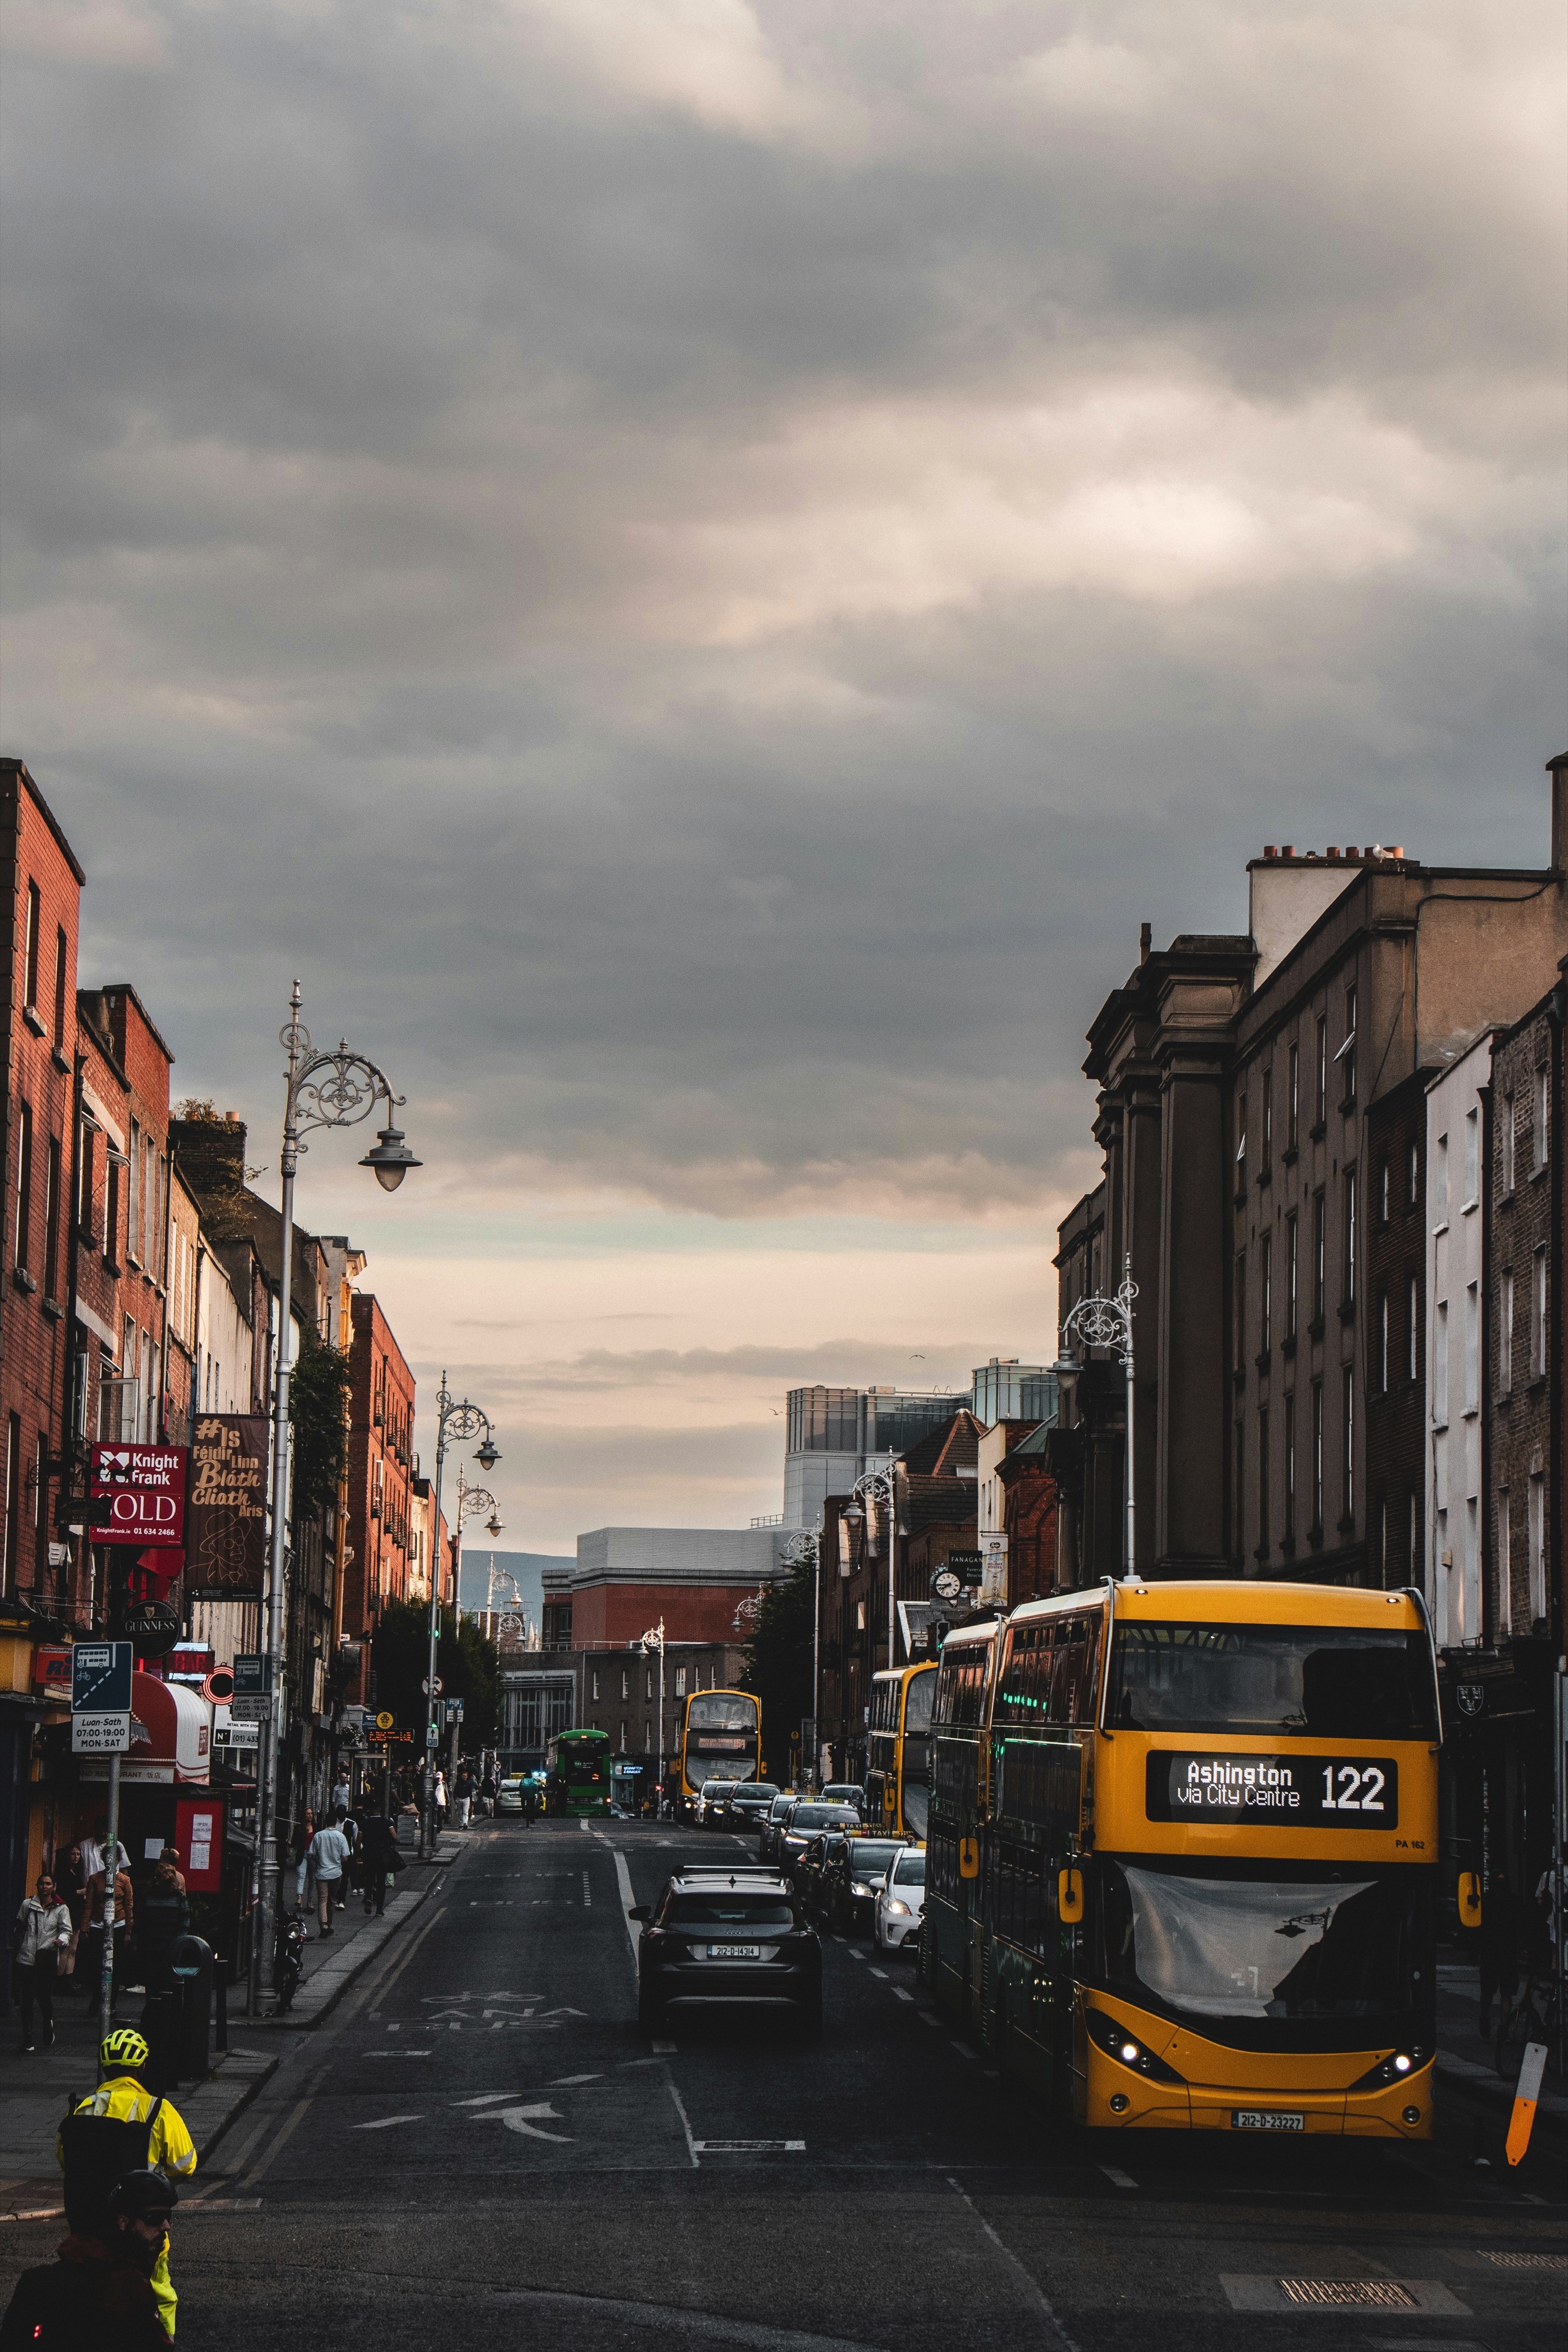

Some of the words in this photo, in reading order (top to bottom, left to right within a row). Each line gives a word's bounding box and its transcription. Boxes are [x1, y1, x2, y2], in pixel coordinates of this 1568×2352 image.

[193, 1445, 232, 1460] Féidir
[133, 1452, 179, 1471] Knight
[232, 1455, 259, 1468] Linn
[132, 1470, 170, 1485] Frank
[195, 1459, 260, 1488] Bláth
[192, 1488, 251, 1506] Cliath
[99, 1494, 176, 1521] OLD
[239, 1505, 263, 1517] Arís
[125, 1621, 175, 1632] GUINNESS
[175, 1653, 206, 1671] BAR
[82, 1718, 122, 1726] Luan-Sath
[76, 1729, 125, 1737] 07:00-19:00
[81, 1739, 121, 1748] MON-SAT
[1188, 1761, 1292, 1787] Ashington
[1322, 1765, 1385, 1810] 122
[1178, 1784, 1201, 1804] via
[1207, 1784, 1239, 1805] City
[1245, 1785, 1300, 1807] Centre
[1396, 1839, 1409, 1849] PA
[1411, 1841, 1425, 1850] 162
[717, 1947, 754, 1955] 212-D-14314
[1241, 2115, 1300, 2129] 212-D-23227
